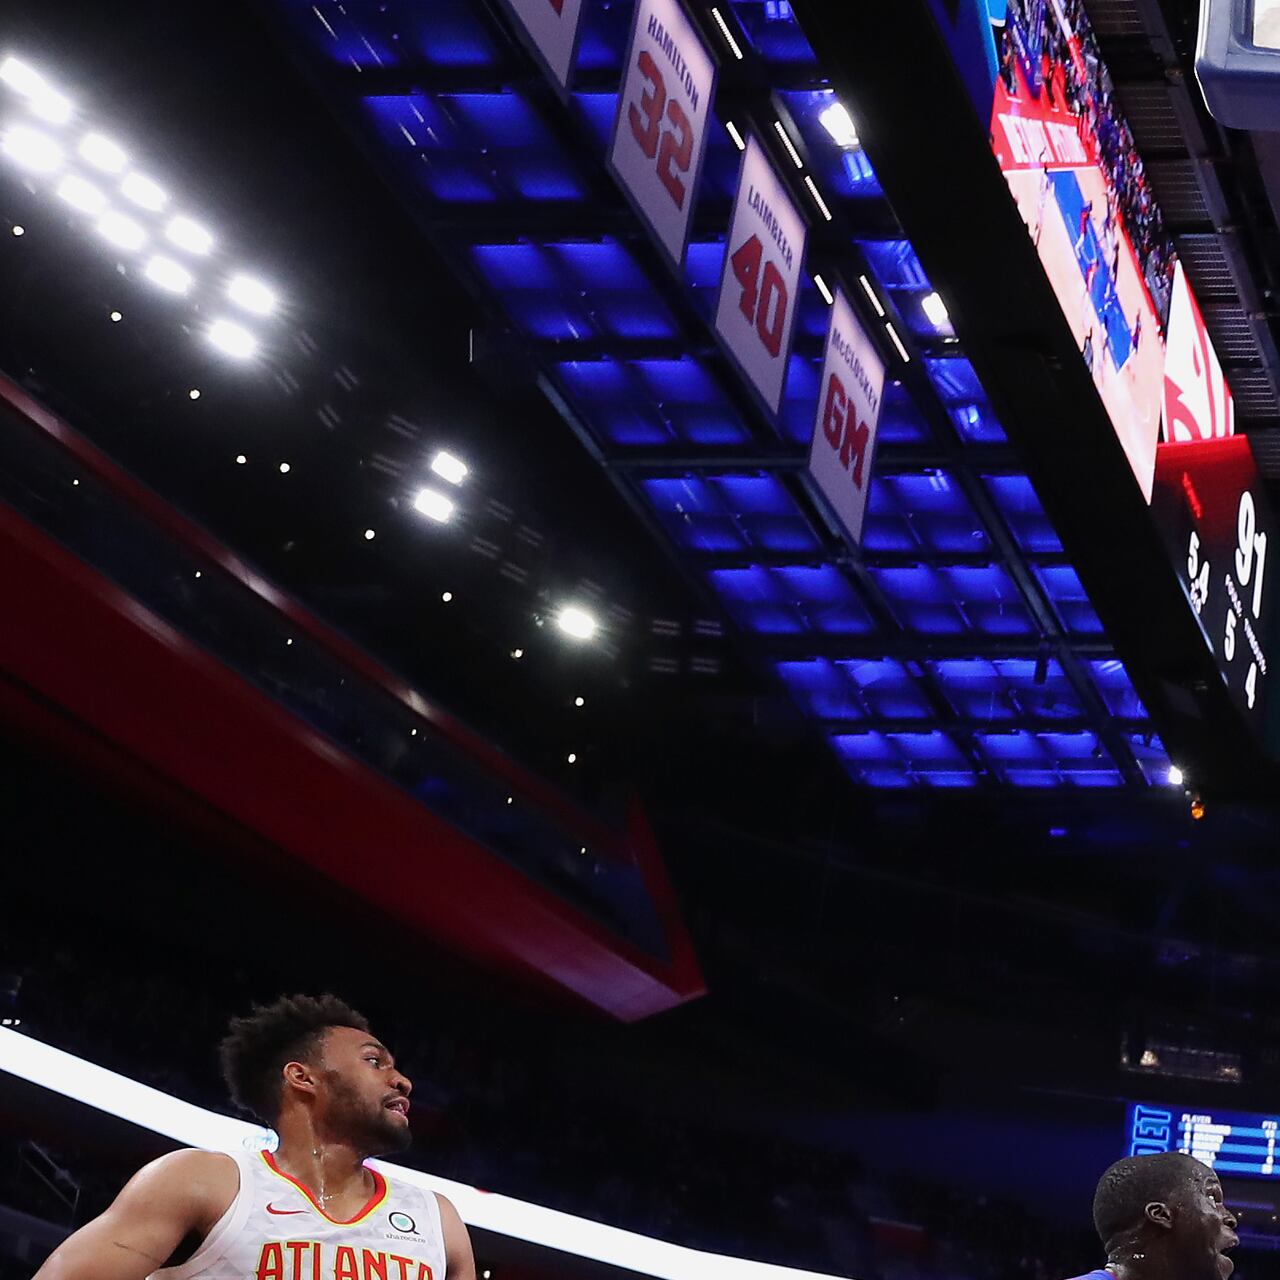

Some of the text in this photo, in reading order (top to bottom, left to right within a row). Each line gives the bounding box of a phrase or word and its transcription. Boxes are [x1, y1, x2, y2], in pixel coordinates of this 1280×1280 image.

[647, 13, 699, 113] HAMILTON
[628, 50, 694, 212] 32
[747, 185, 793, 270] LAIMBEER
[731, 233, 788, 358] 40
[823, 372, 870, 490] GM
[1235, 490, 1267, 619] 91
[1224, 608, 1236, 661] 5
